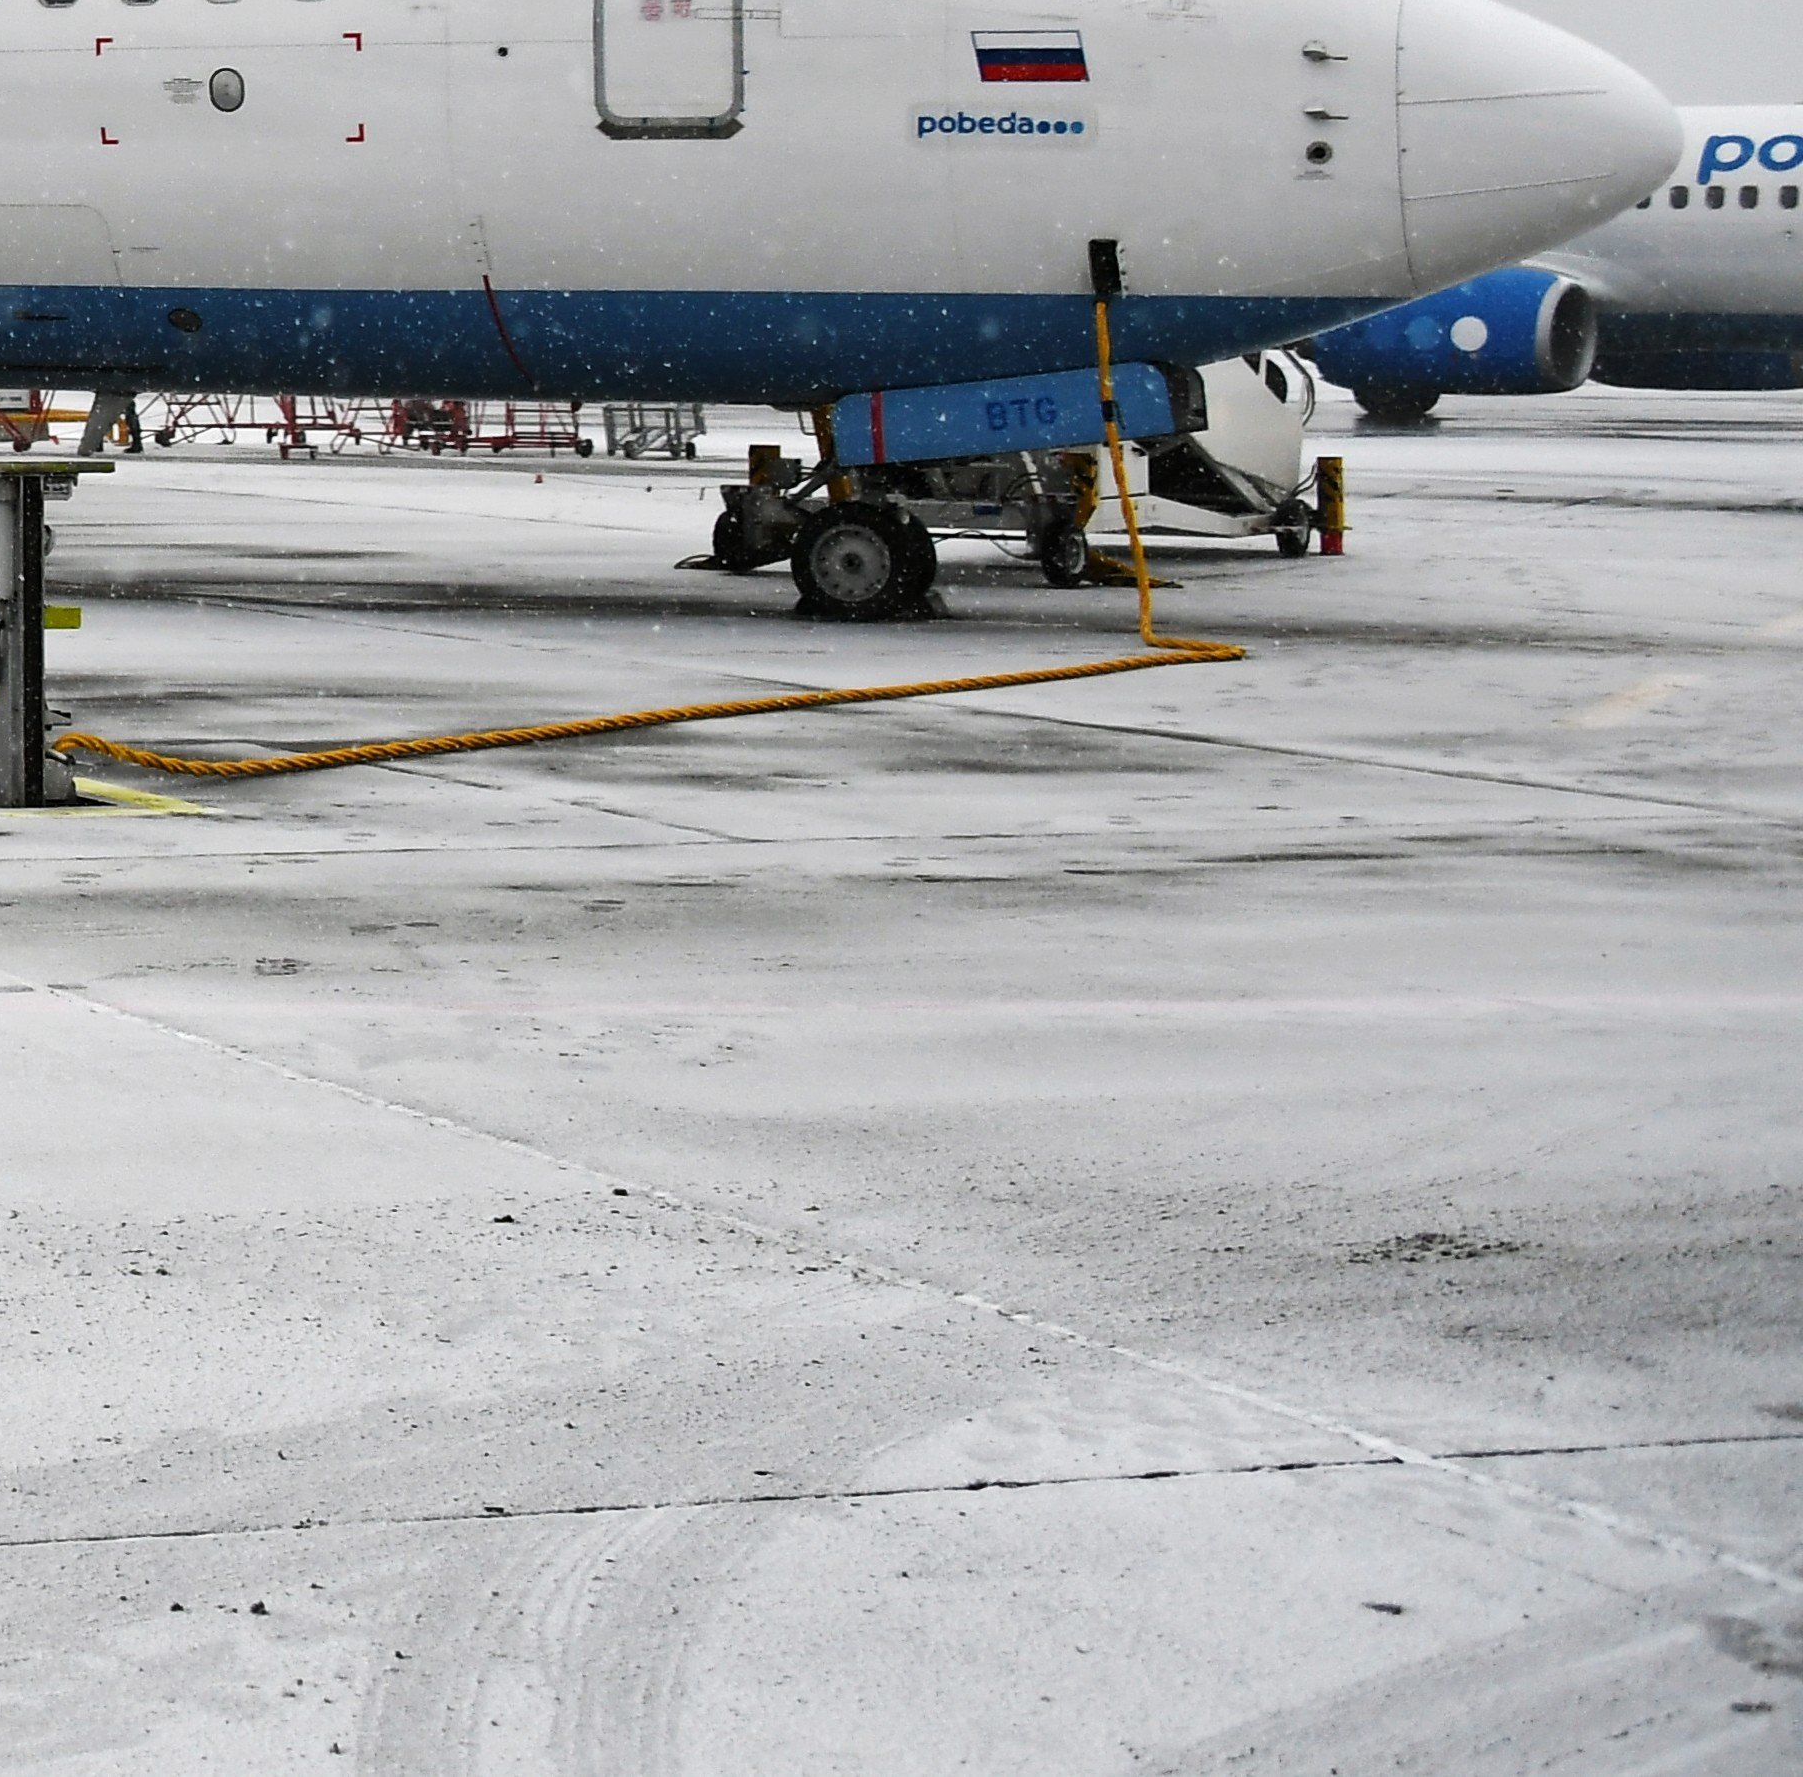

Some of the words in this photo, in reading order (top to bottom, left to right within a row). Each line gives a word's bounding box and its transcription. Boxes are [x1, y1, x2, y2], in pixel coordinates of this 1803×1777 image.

[917, 111, 1034, 139] pobeda
[1697, 135, 1803, 185] po
[986, 397, 1057, 431] BTG
